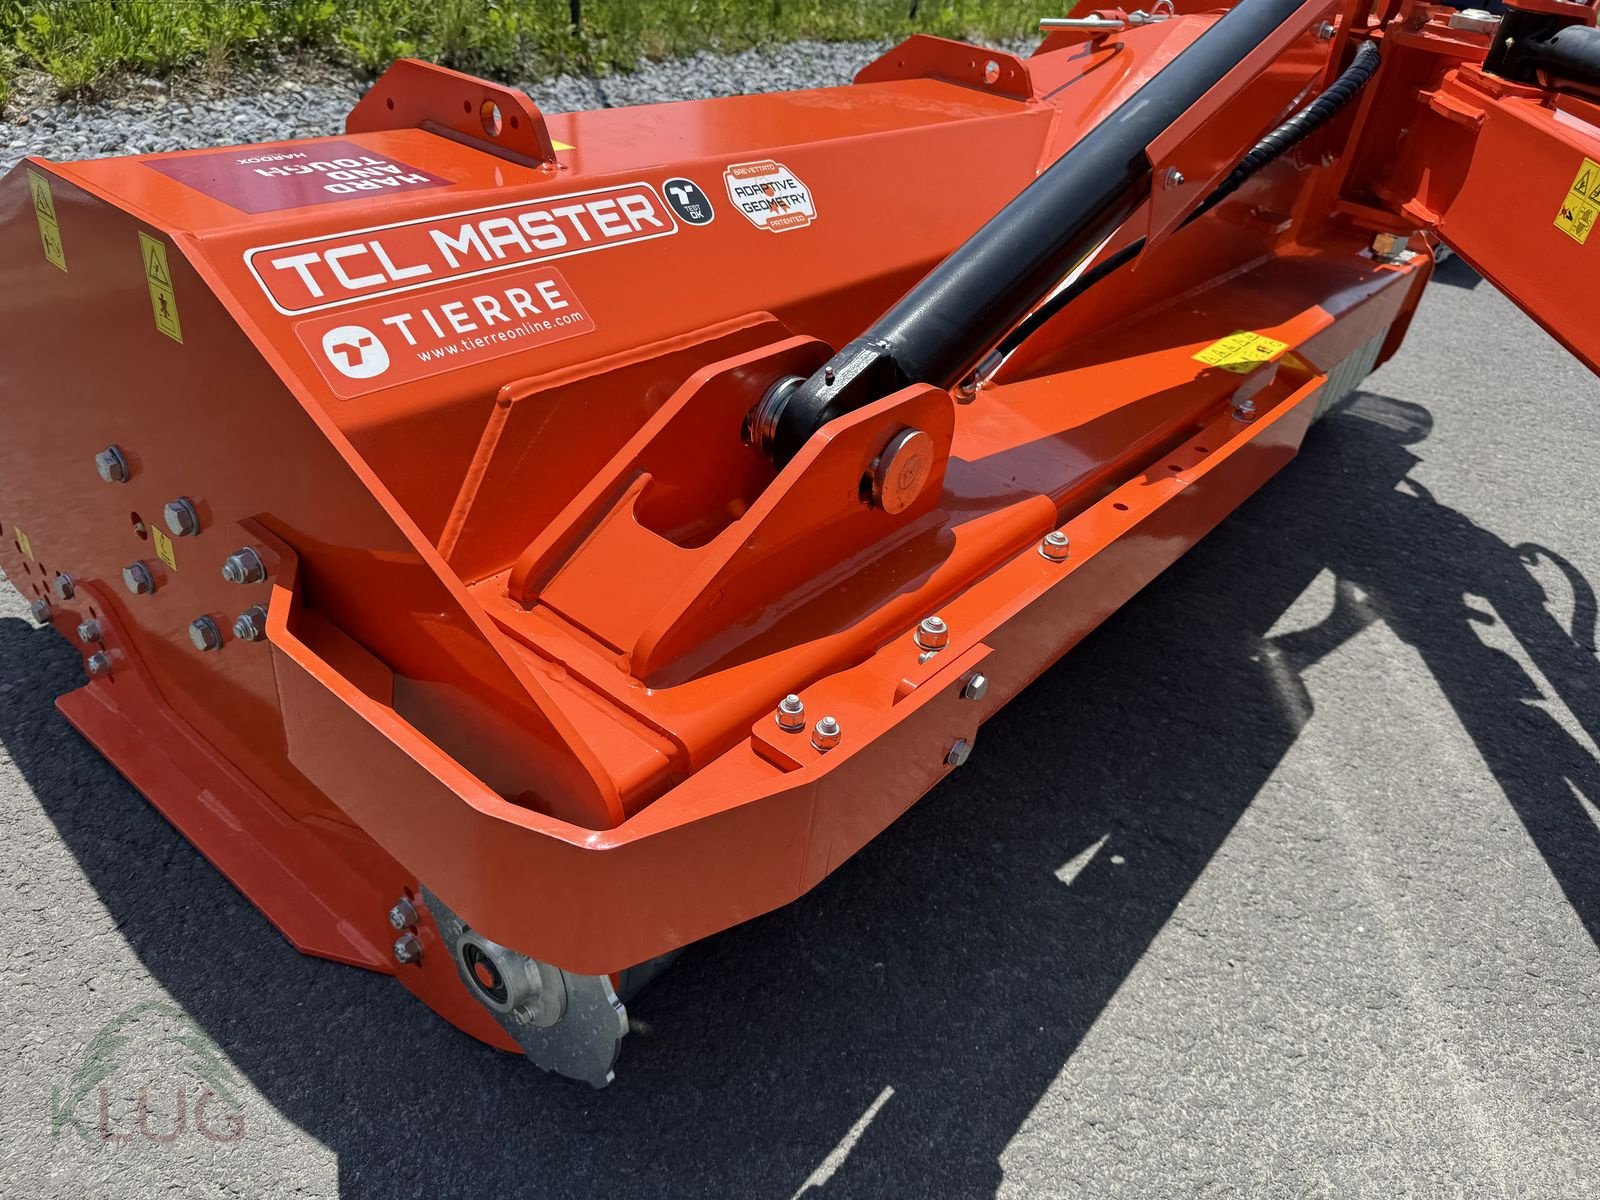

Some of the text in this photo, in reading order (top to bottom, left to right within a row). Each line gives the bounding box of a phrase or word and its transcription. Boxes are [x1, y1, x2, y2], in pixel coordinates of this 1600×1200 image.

[238, 152, 307, 165] HARDOX
[254, 156, 387, 177] TOUGH
[326, 164, 403, 181] AND
[323, 173, 431, 194] HARD
[734, 179, 797, 198] ADAPTIVE
[684, 204, 701, 212] TEST
[742, 193, 807, 213] GEOMETRY
[690, 210, 704, 219] OK
[770, 215, 805, 227] PATENTED
[271, 194, 664, 298] TCL MASTER
[382, 279, 569, 346] TIERRE
[417, 311, 584, 362] www.tierreonline.com
